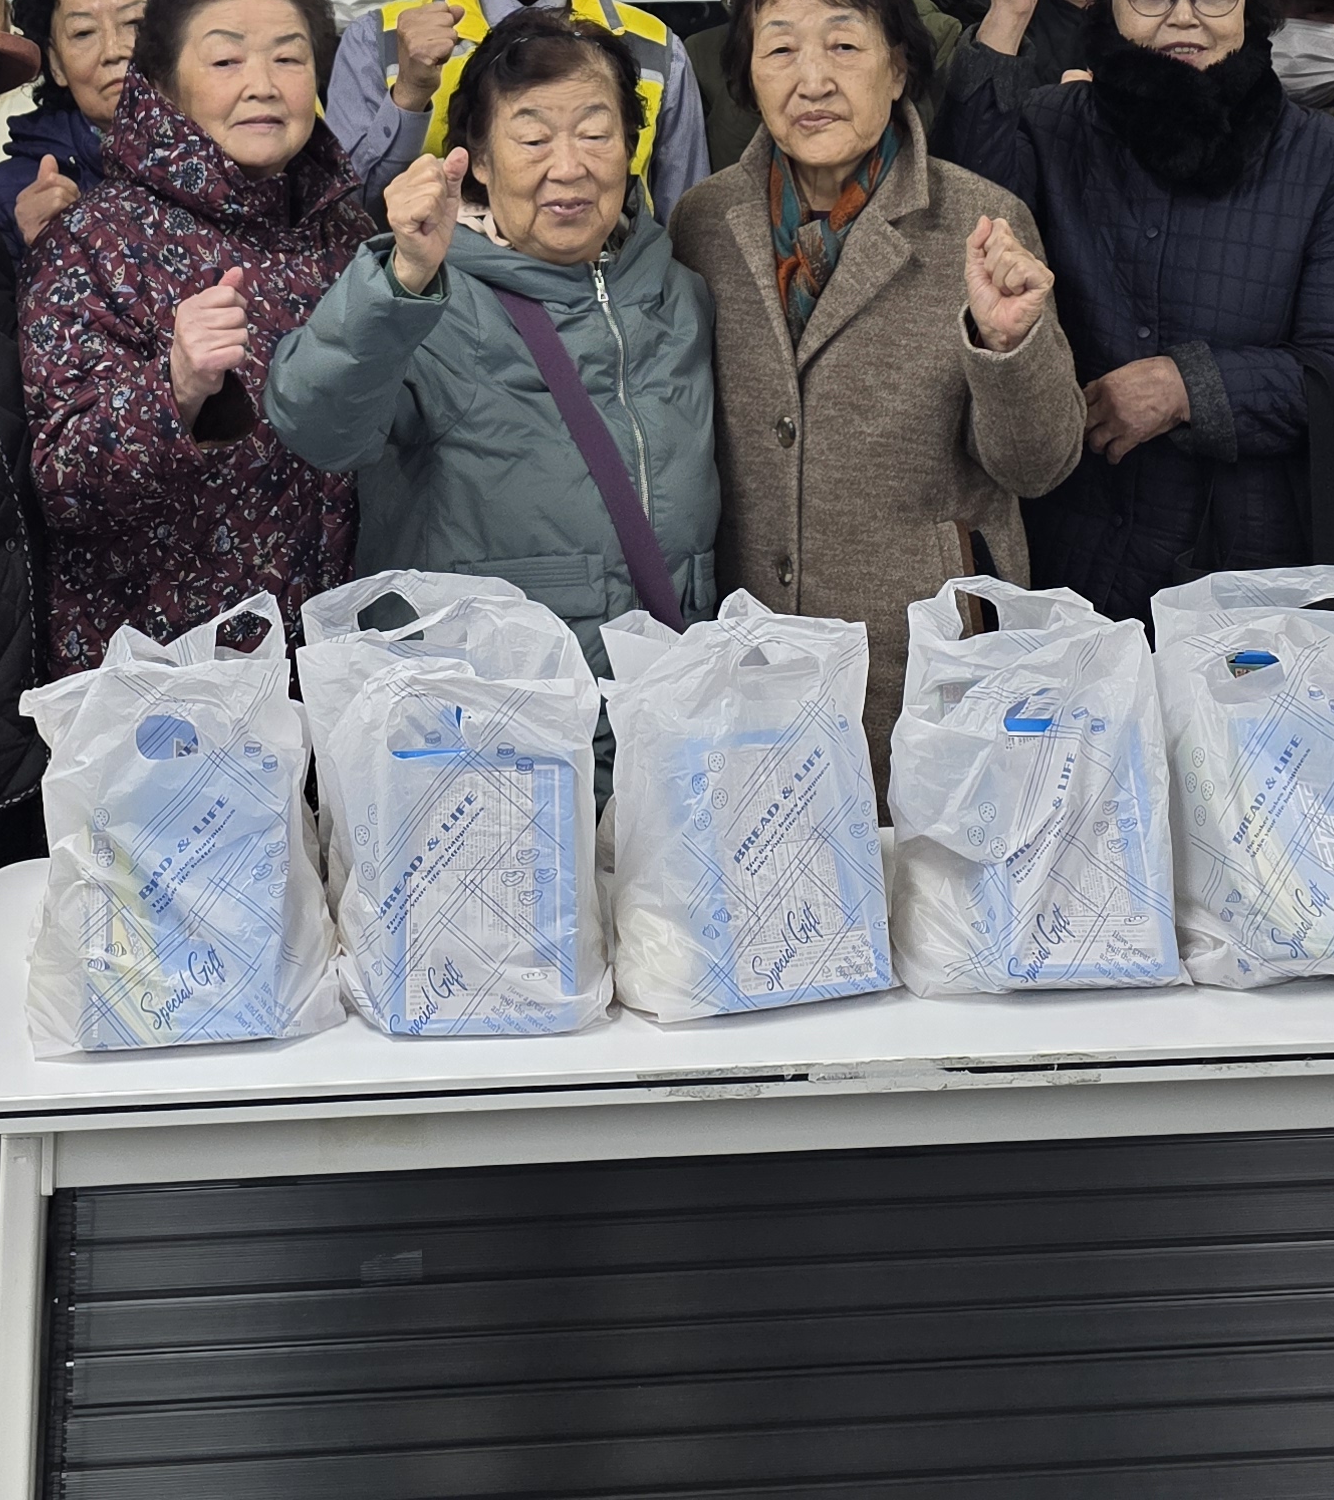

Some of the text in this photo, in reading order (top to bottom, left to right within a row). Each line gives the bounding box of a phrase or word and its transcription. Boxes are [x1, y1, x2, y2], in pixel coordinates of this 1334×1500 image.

[733, 803, 779, 864] BREAD
[782, 786, 793, 799] &
[794, 745, 825, 782] LIFE
[1052, 752, 1077, 810] & LIFE
[1233, 734, 1303, 845] BREAD & LIFE
[1244, 748, 1311, 852] The baker bakes happiness
[177, 838, 191, 853] &
[192, 794, 229, 834] LIFE
[427, 836, 440, 851] &
[441, 791, 478, 832] LIFE
[444, 804, 483, 854] happiness
[745, 855, 758, 871] The
[798, 760, 830, 802] happiness
[750, 853, 768, 877] Make
[769, 832, 785, 852] your
[784, 817, 796, 831] life
[796, 789, 817, 816] better
[1249, 780, 1300, 857] Make your life better
[191, 840, 216, 870] better
[410, 886, 427, 907] your
[428, 869, 441, 884] life
[442, 838, 465, 868] better
[752, 902, 823, 991] Special Gift
[862, 955, 875, 968] the
[871, 965, 891, 984] sweet
[1007, 903, 1076, 983] Special Gift
[1098, 951, 1125, 974] and the
[1104, 939, 1123, 956] with
[1119, 950, 1133, 964] the
[1130, 959, 1151, 977] sweet
[1110, 929, 1130, 947] Have
[1127, 943, 1134, 951] a
[1132, 945, 1152, 963] great
[1147, 957, 1163, 972] day
[141, 976, 193, 1031] Special
[188, 943, 225, 987] Gift
[428, 956, 468, 999] Gift
[242, 1000, 259, 1016] and
[490, 1003, 505, 1018] and
[502, 1013, 517, 1027] the
[498, 991, 543, 1030] with the sweet
[526, 997, 546, 1015] great
[542, 1008, 559, 1024] day
